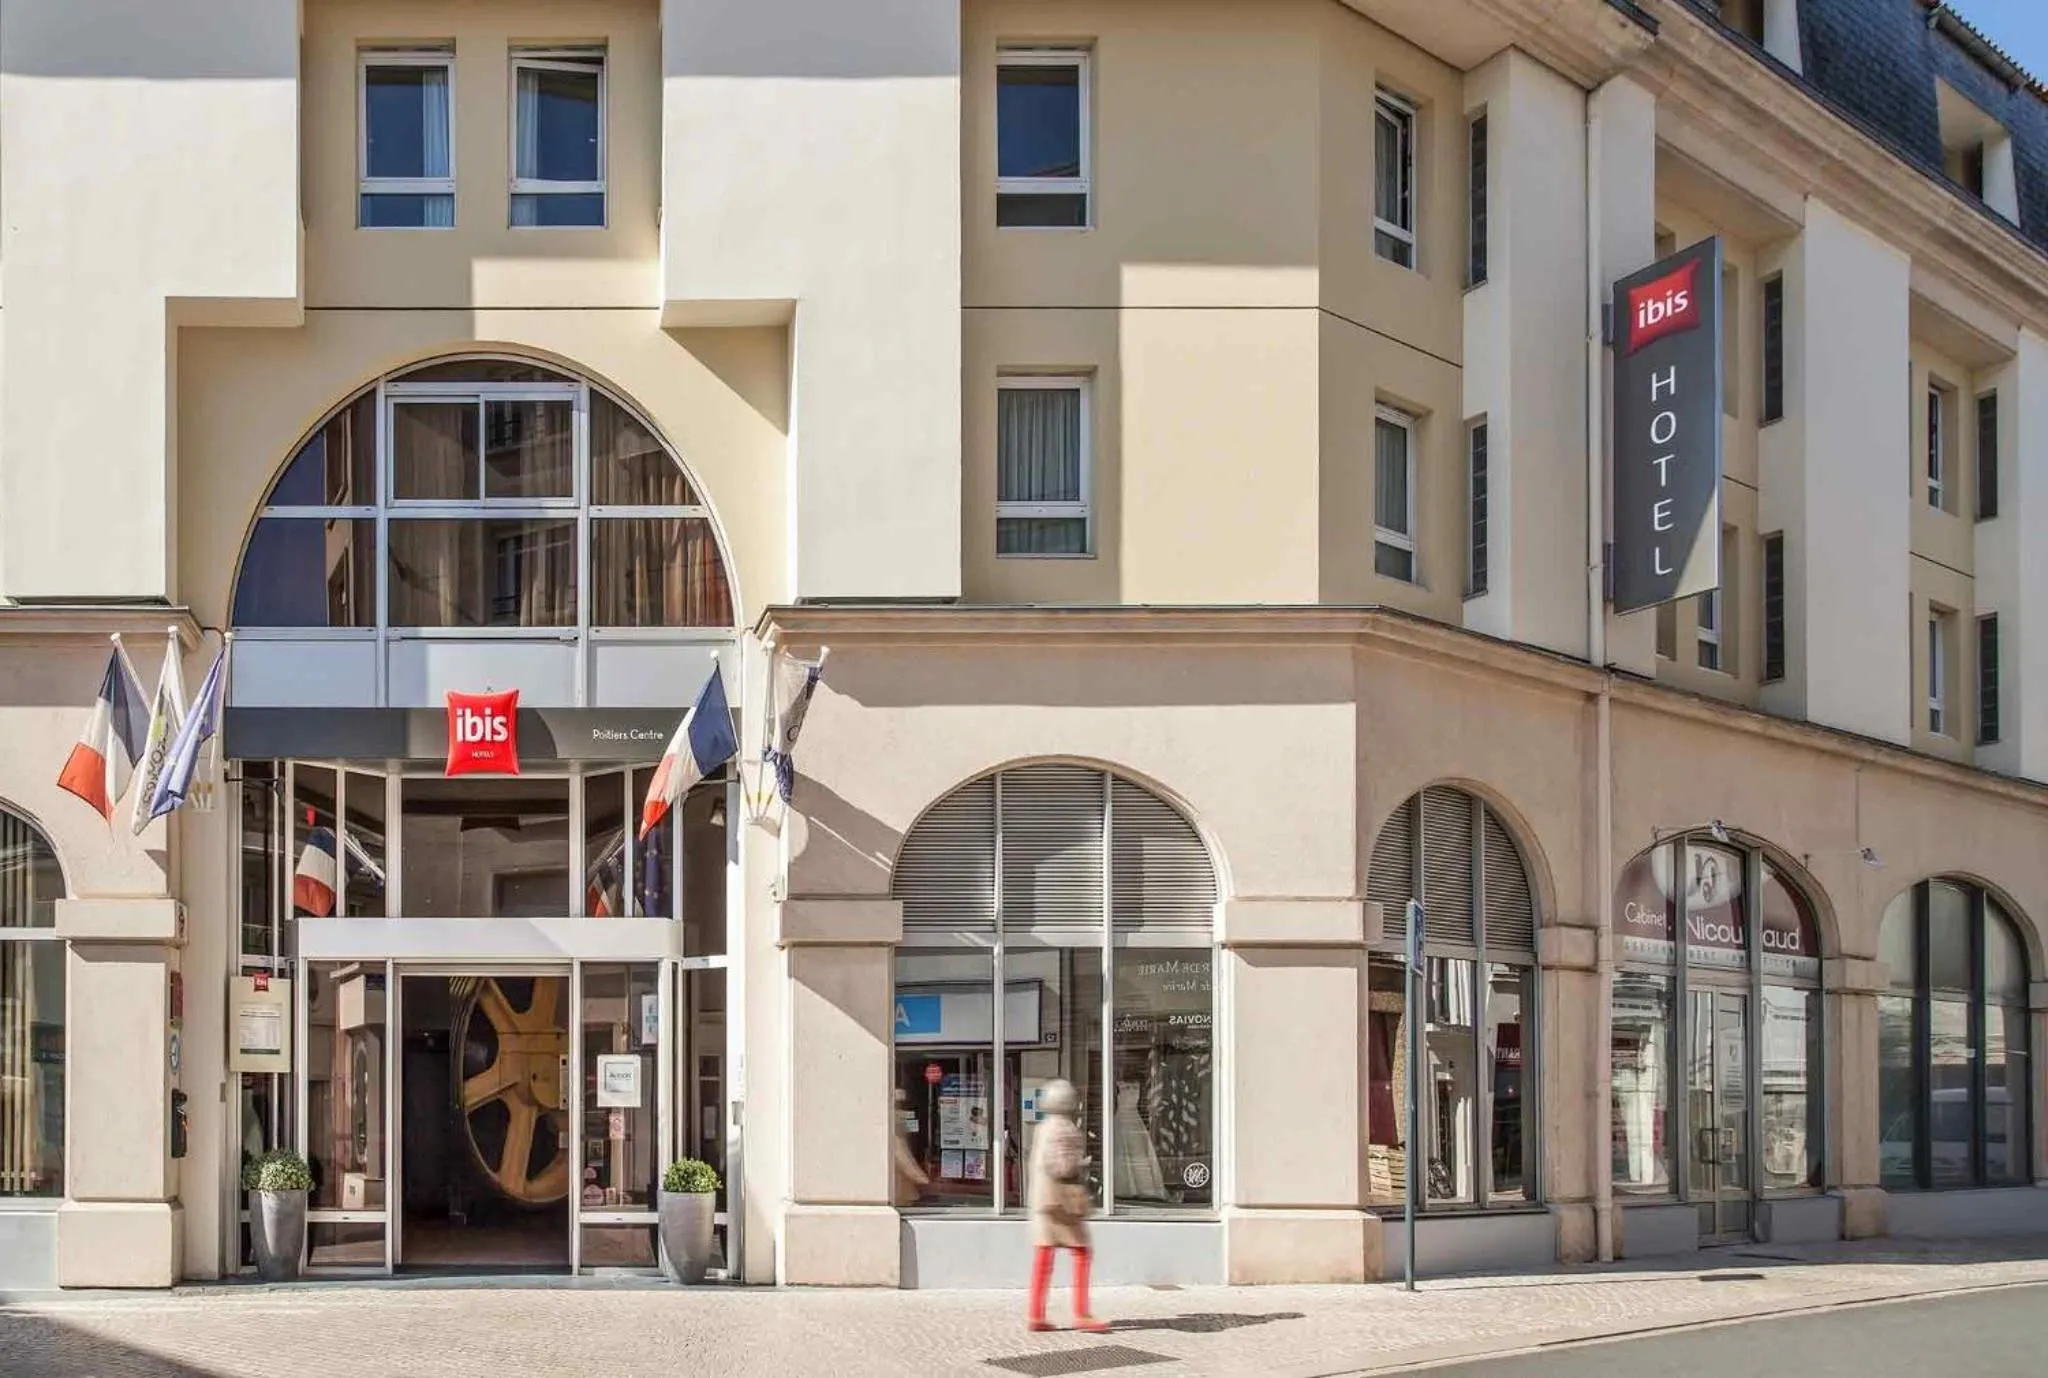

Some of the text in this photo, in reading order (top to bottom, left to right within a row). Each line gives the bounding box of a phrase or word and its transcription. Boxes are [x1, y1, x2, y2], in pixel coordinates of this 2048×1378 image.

[1639, 289, 1688, 329] ibis
[1650, 365, 1676, 576] HOTEL
[456, 707, 509, 743] ibis
[592, 728, 664, 740] Poitiers Centre
